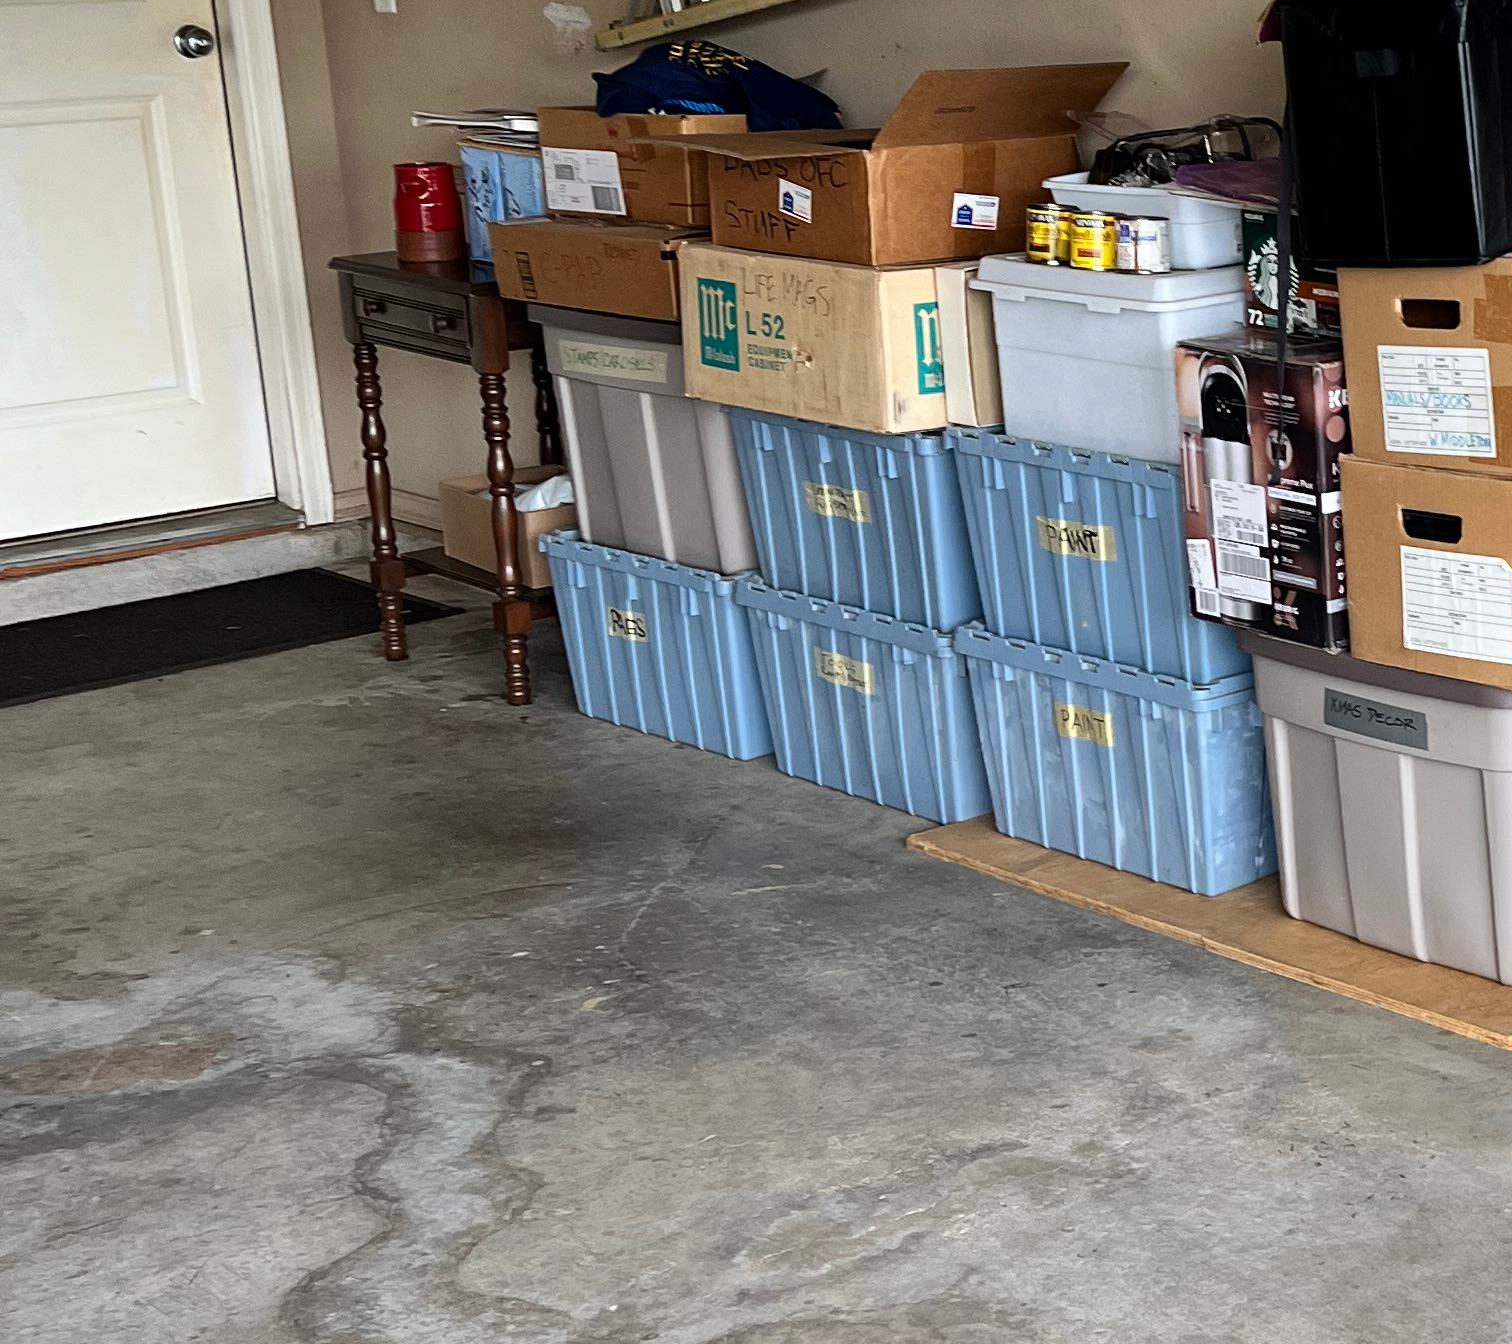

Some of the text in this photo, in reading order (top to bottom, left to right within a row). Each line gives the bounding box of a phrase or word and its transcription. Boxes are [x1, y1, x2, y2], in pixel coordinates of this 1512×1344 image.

[724, 199, 800, 243] STUFF
[745, 310, 786, 341] L 52
[1247, 308, 1265, 326] 72
[746, 342, 793, 360] EQUIPMEN
[748, 356, 787, 373] CABINET
[1045, 524, 1099, 554] PAINT
[1060, 708, 1106, 739] PAINT
[1366, 707, 1418, 732] DECOR
